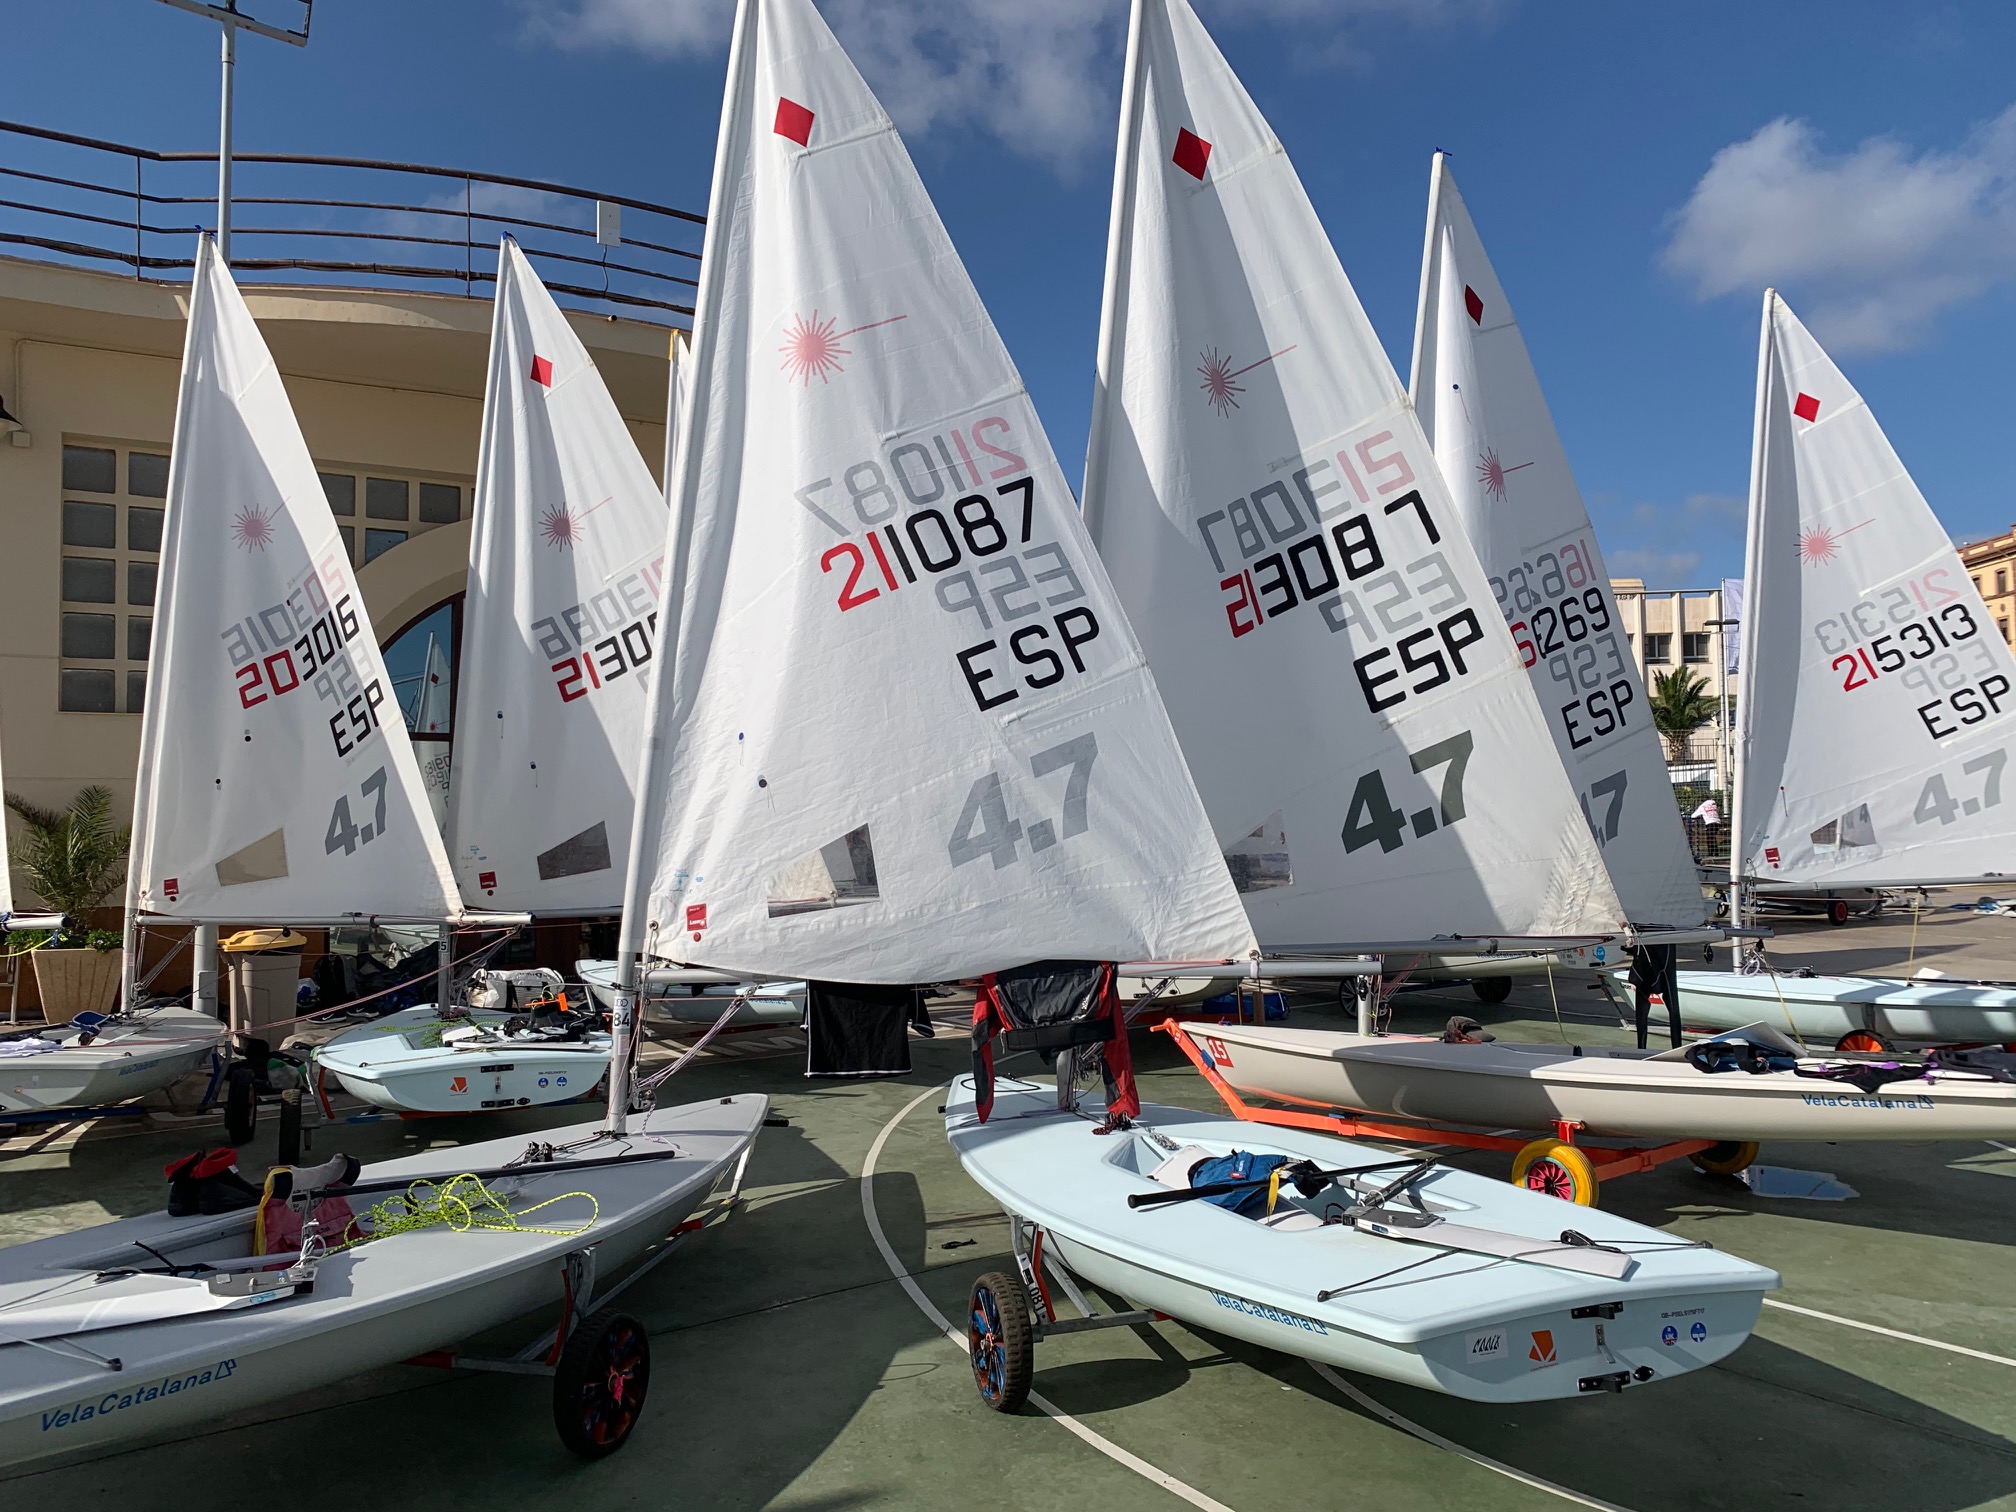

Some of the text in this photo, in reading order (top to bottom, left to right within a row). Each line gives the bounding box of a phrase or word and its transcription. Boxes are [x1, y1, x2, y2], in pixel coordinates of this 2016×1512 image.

[820, 476, 1034, 613] 211087
[1219, 489, 1441, 638] 213087
[235, 593, 360, 710] 203016
[552, 611, 657, 703] 2130
[956, 606, 1100, 712] ESP
[1353, 608, 1484, 713] ESP
[1831, 603, 1978, 692] 215313
[329, 678, 384, 758] ESP
[1561, 678, 1634, 750] ESP
[1917, 675, 2010, 739] ESP
[323, 765, 388, 857] 4.7
[947, 731, 1099, 871] 4.7
[1340, 730, 1475, 854] 4.7
[1912, 747, 2008, 827] 4.7
[613, 1012, 630, 1027] 84
[1208, 1039, 1227, 1060] 15
[1800, 1093, 1918, 1109] VelaCatalana
[1029, 1286, 1046, 1312] 081
[1208, 1289, 1314, 1332] VelaCatalana
[41, 1370, 213, 1432] VelaCatalana
